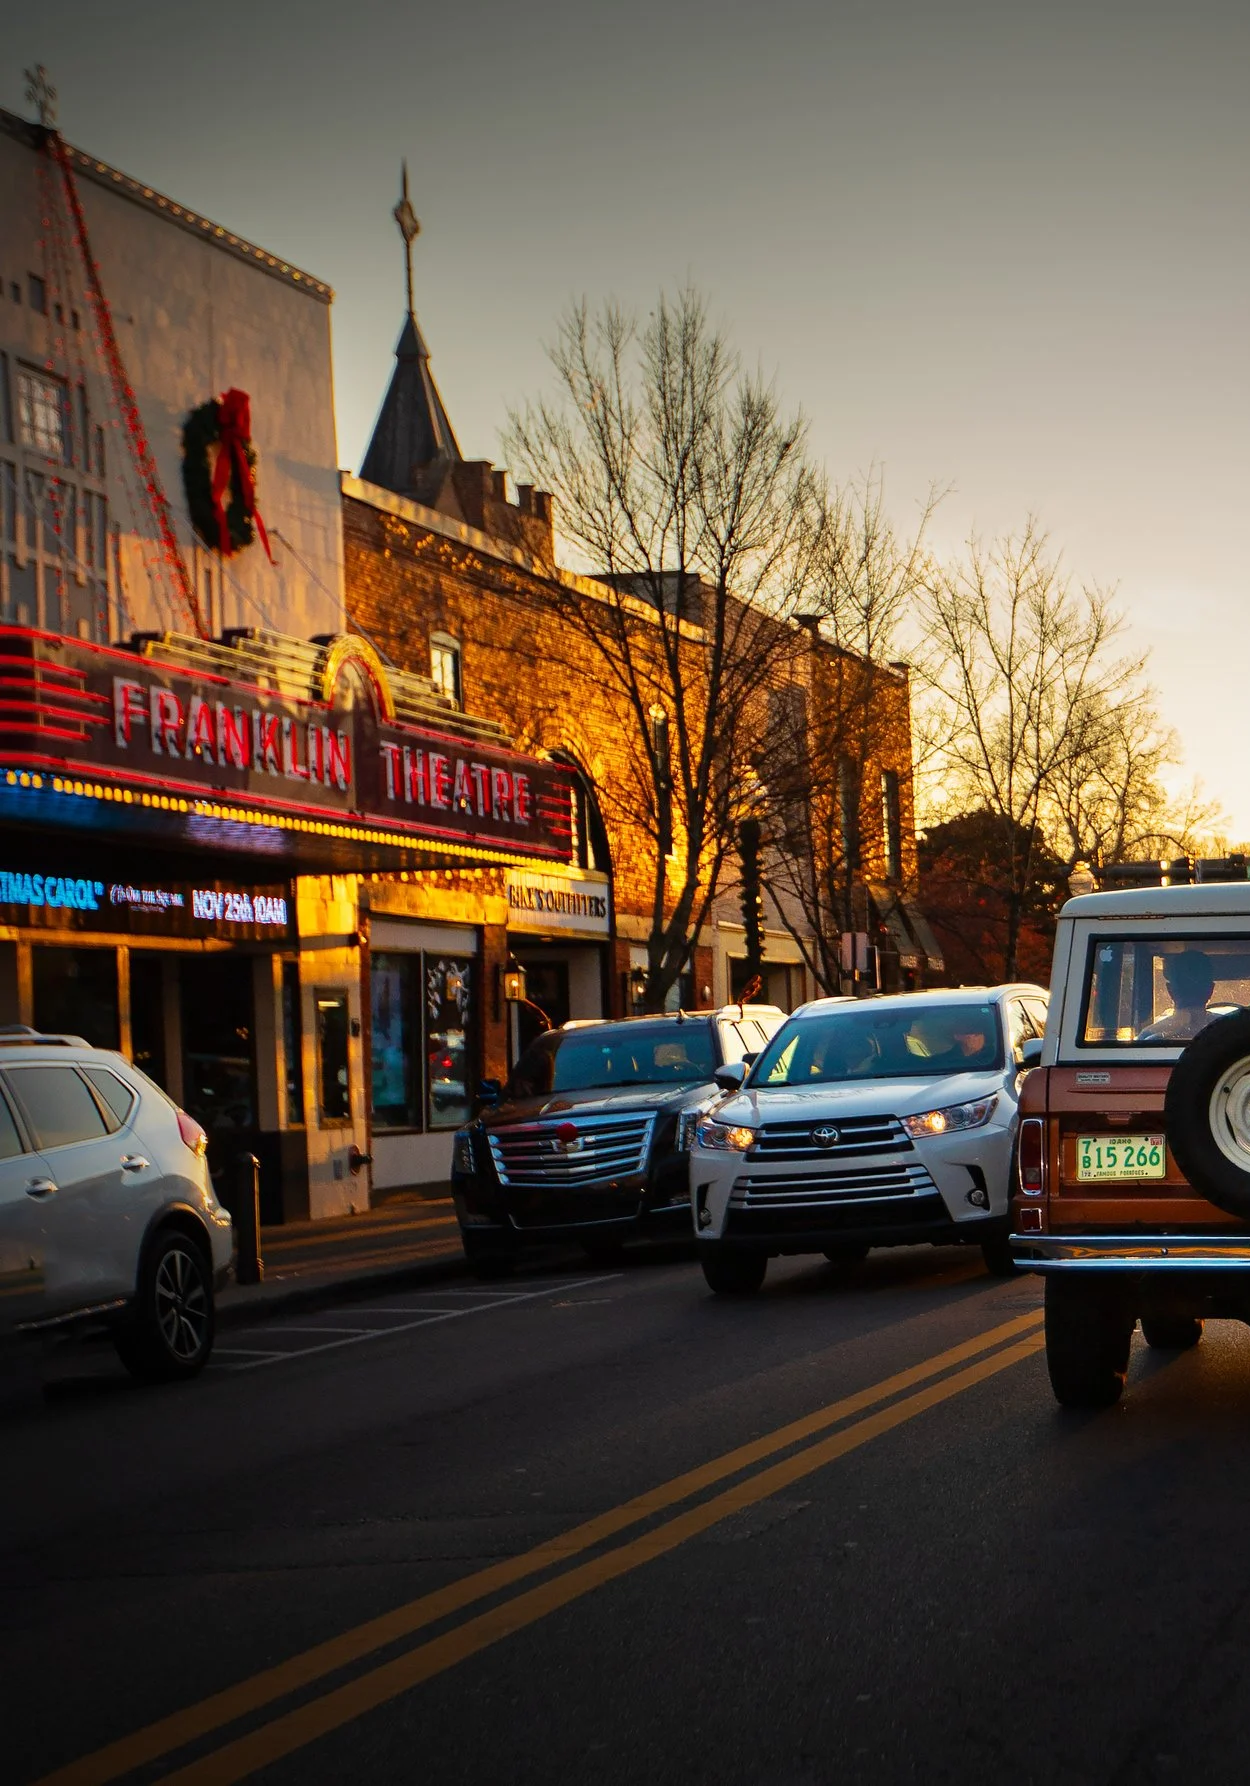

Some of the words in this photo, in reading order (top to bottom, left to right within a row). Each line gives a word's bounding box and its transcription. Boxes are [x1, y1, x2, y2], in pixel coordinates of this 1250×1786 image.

[113, 676, 351, 791] FRANKLIN
[380, 740, 531, 826] THEATRE
[192, 889, 224, 919] NOV
[225, 892, 254, 922] 25th
[253, 895, 287, 925] 10AM
[545, 889, 606, 918] OUTFITTERS
[1096, 1146, 1118, 1169] 15
[1124, 1145, 1160, 1168] 266
